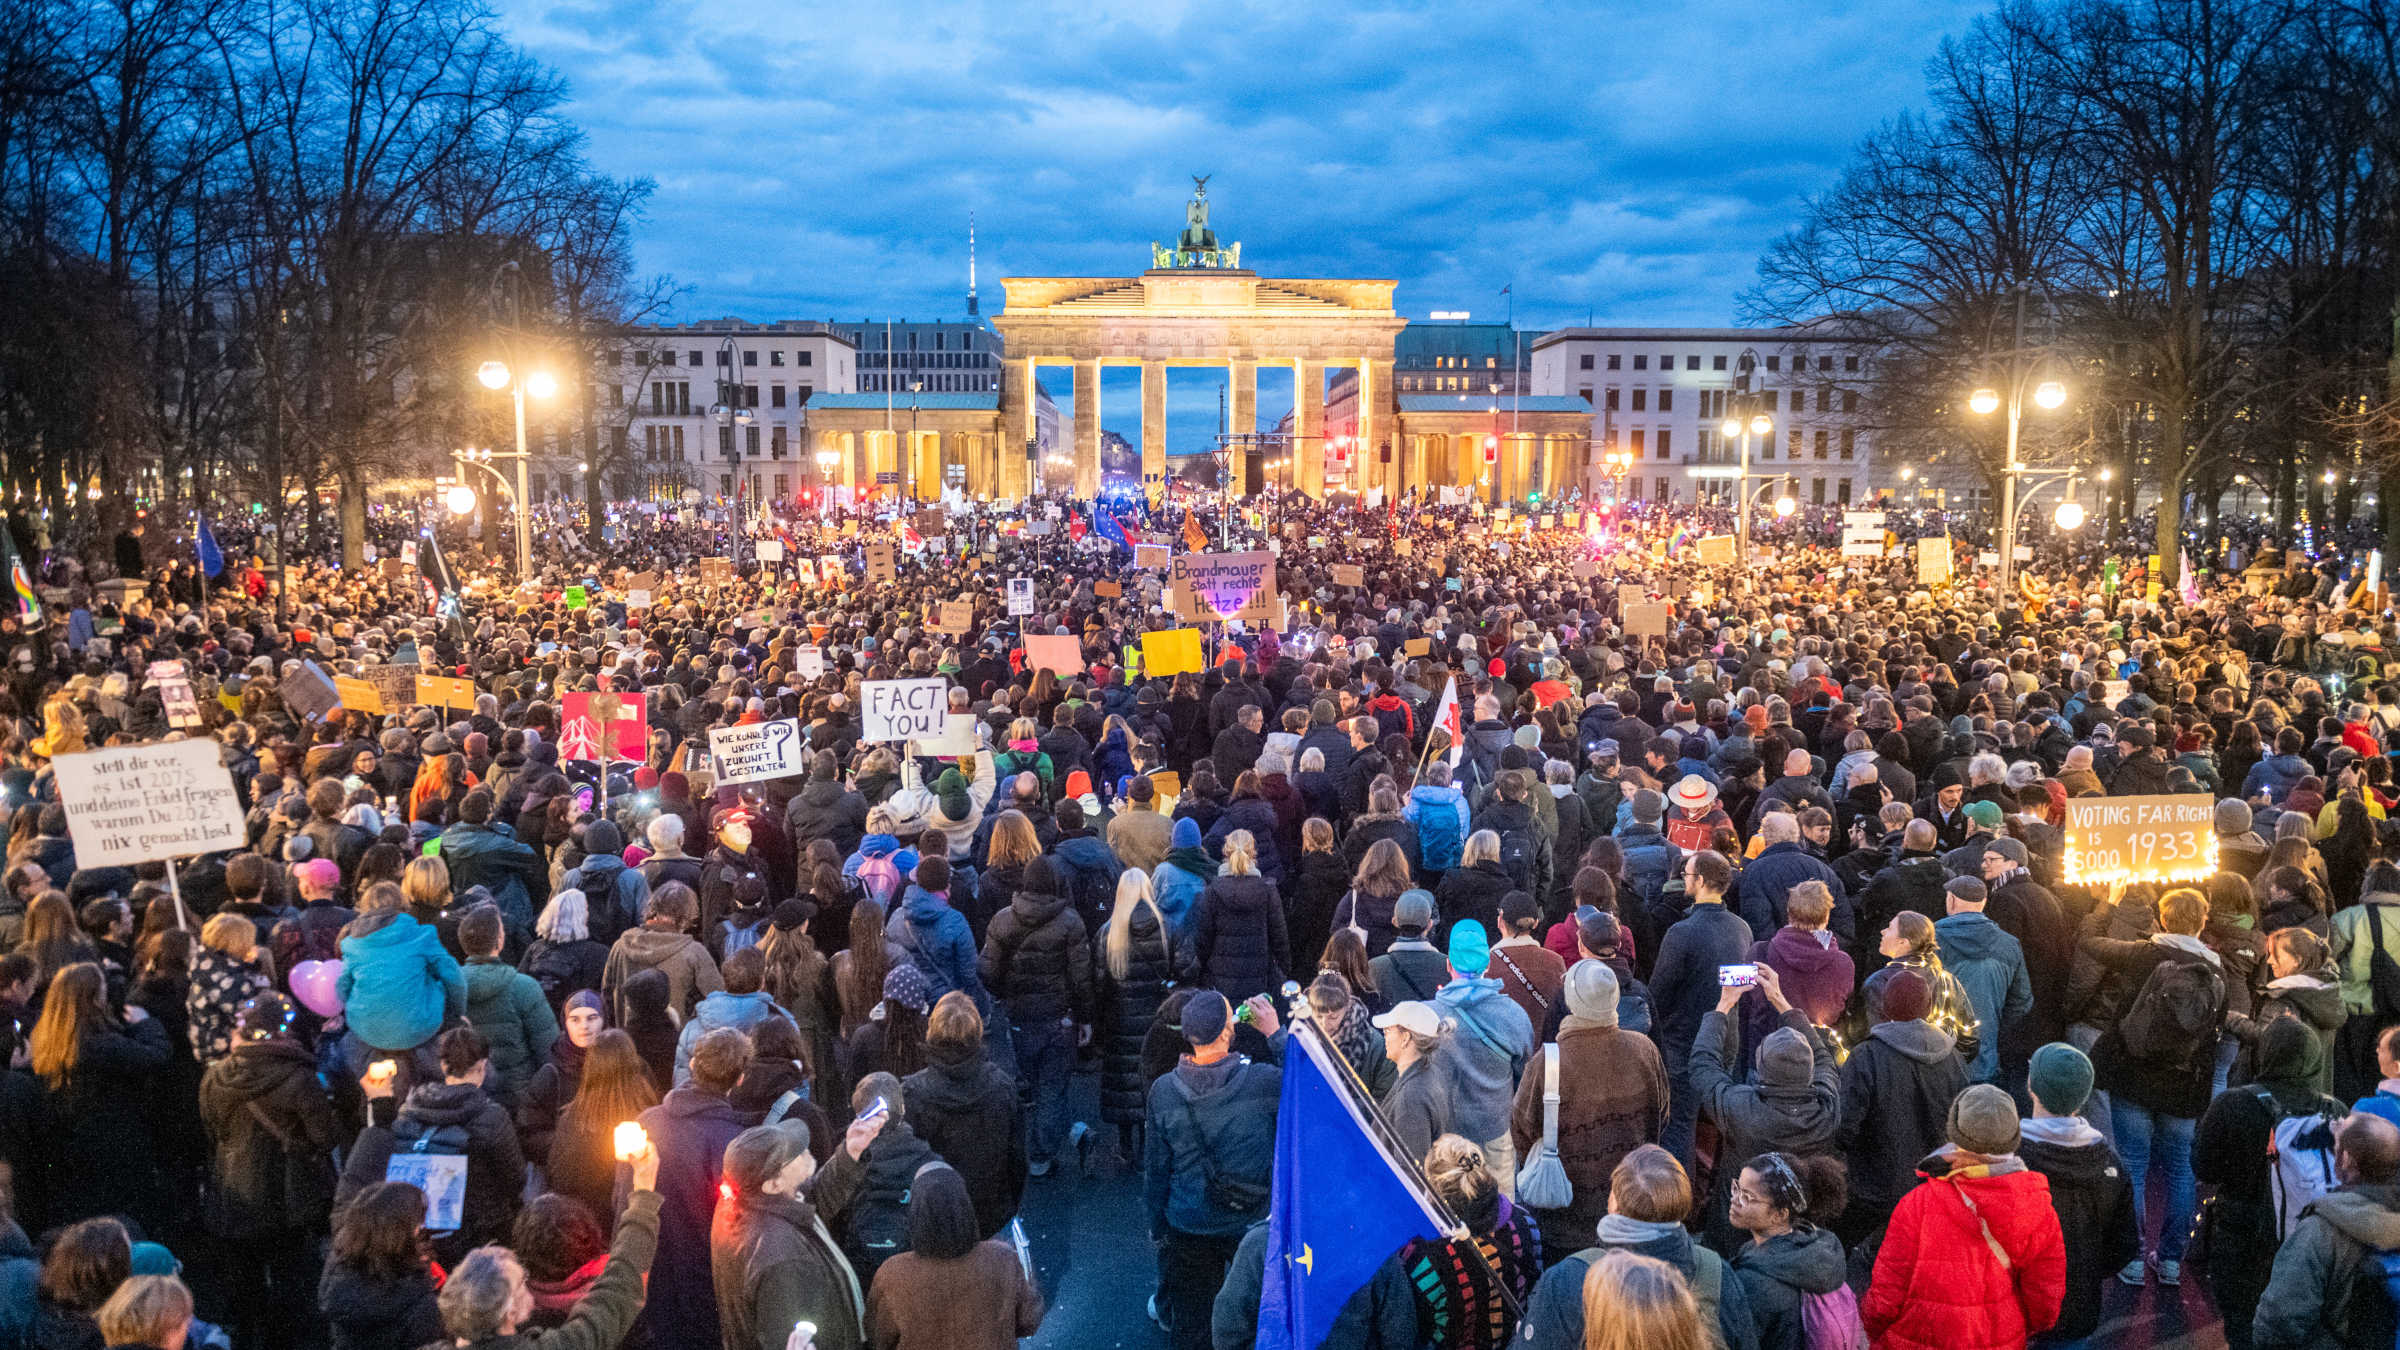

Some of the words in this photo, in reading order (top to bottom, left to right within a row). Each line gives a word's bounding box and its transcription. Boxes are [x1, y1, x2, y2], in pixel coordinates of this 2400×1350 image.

[1175, 559, 1267, 580] Brandmauer
[1190, 578, 1216, 592] statt
[1223, 576, 1261, 590] rechte
[873, 686, 942, 714] FACT
[717, 736, 734, 744] WIE
[773, 727, 788, 736] WIR
[726, 752, 772, 766] ZUKUNFT
[731, 742, 768, 754] UNSERE
[129, 755, 149, 770] dir
[729, 761, 787, 776] GESTALTEN
[93, 782, 111, 793] es
[120, 776, 143, 791] ist
[150, 768, 197, 788] 2075
[68, 797, 98, 815] und
[99, 796, 142, 812] deine
[143, 787, 182, 807] Enkel
[183, 786, 233, 806] fragen
[91, 815, 145, 830] warum
[148, 808, 172, 824] Du
[175, 805, 224, 822] 2025
[2071, 804, 2131, 829] VOTING
[102, 834, 131, 851] nix
[138, 827, 199, 852] gemacht
[202, 823, 233, 840] hast
[2088, 832, 2102, 846] IS
[2127, 831, 2198, 865] 1933
